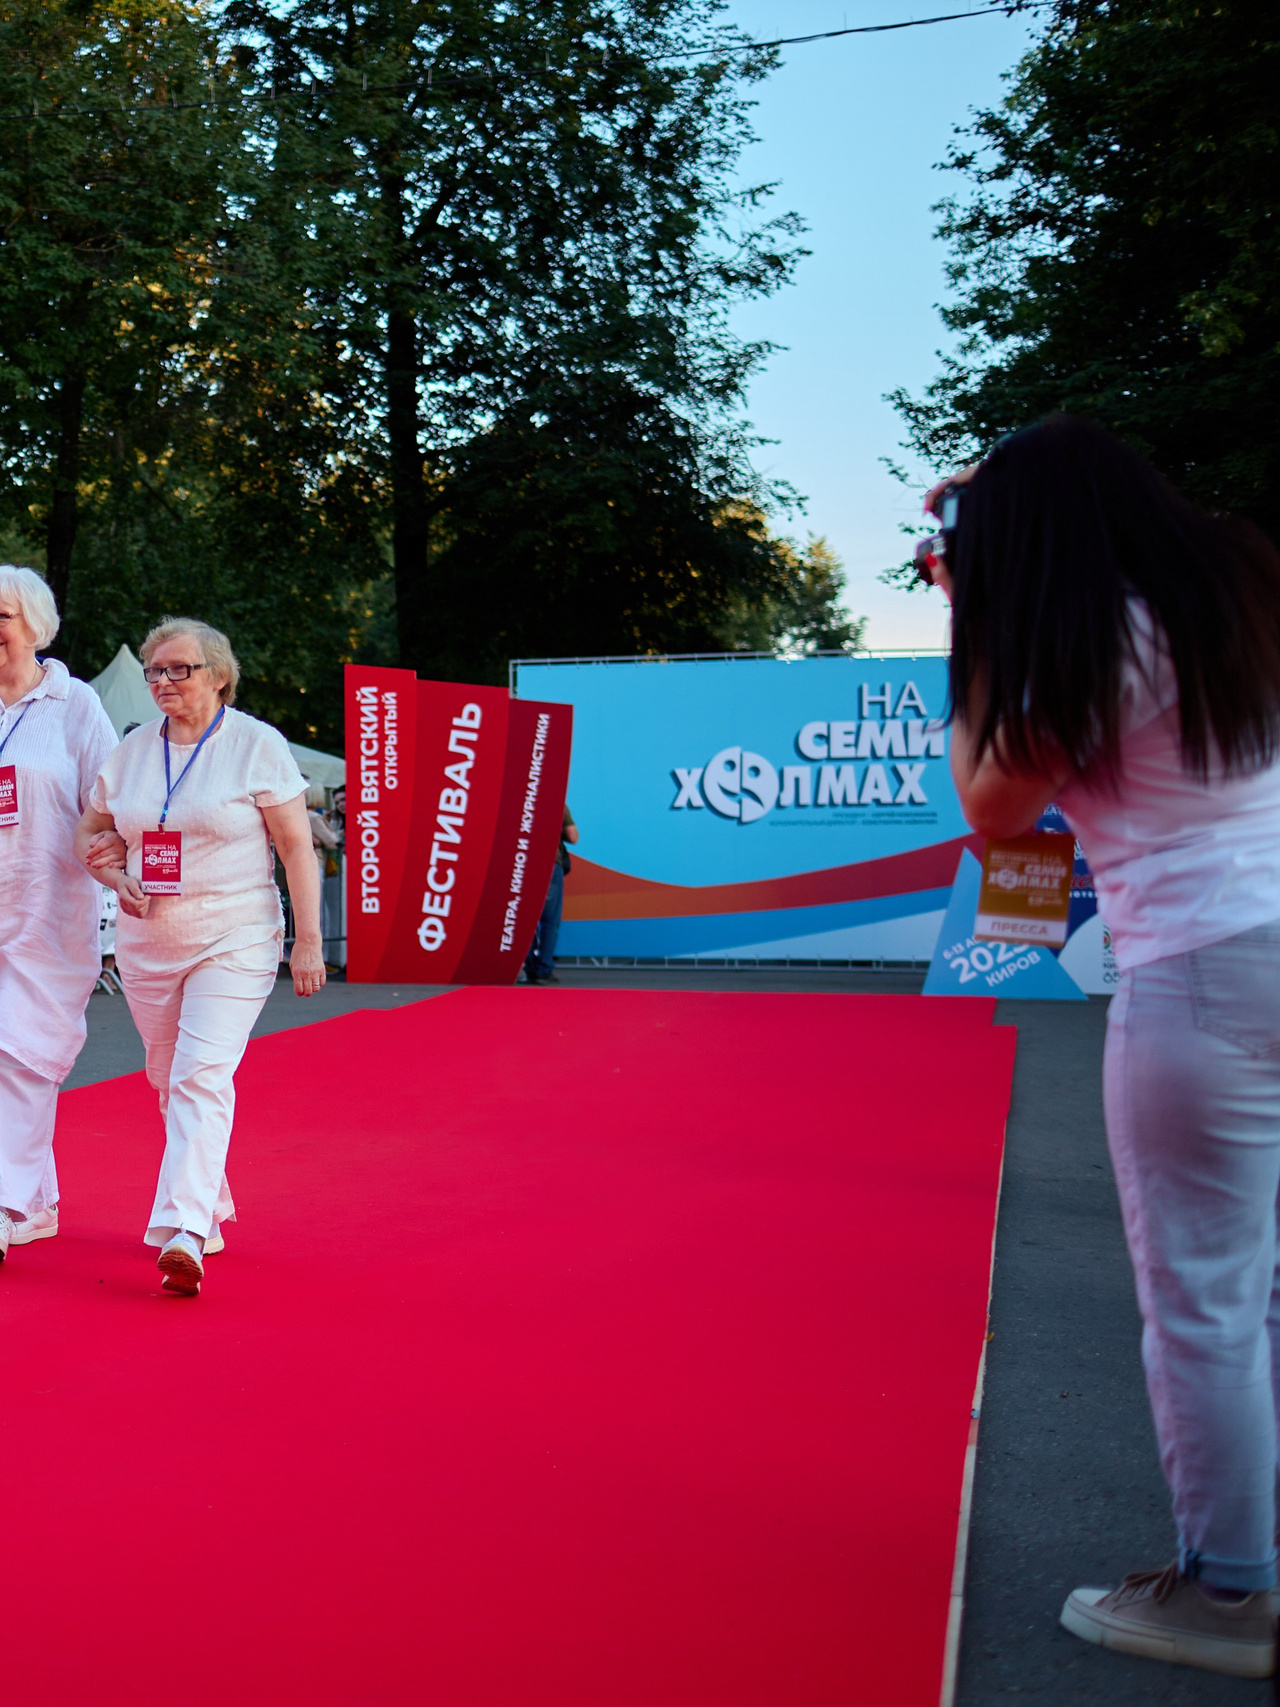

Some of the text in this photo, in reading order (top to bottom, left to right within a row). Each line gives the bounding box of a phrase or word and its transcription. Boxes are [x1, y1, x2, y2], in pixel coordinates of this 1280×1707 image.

[859, 681, 928, 717] НА
[381, 691, 398, 790] ОТКРЫТЫЙ
[797, 719, 946, 760] СЕМИ
[356, 686, 380, 914] ВТОРОЙ ВЯТСКИЙ
[417, 702, 483, 952] ФЕСТИВАЛЬ
[500, 713, 551, 952] ТЕАТРА, КИНО И ЖУРНАЛИСТИКИ
[991, 921, 1049, 936] ПРЕССА
[942, 942, 966, 961] 6-13
[984, 950, 1041, 988] КИРОВ
